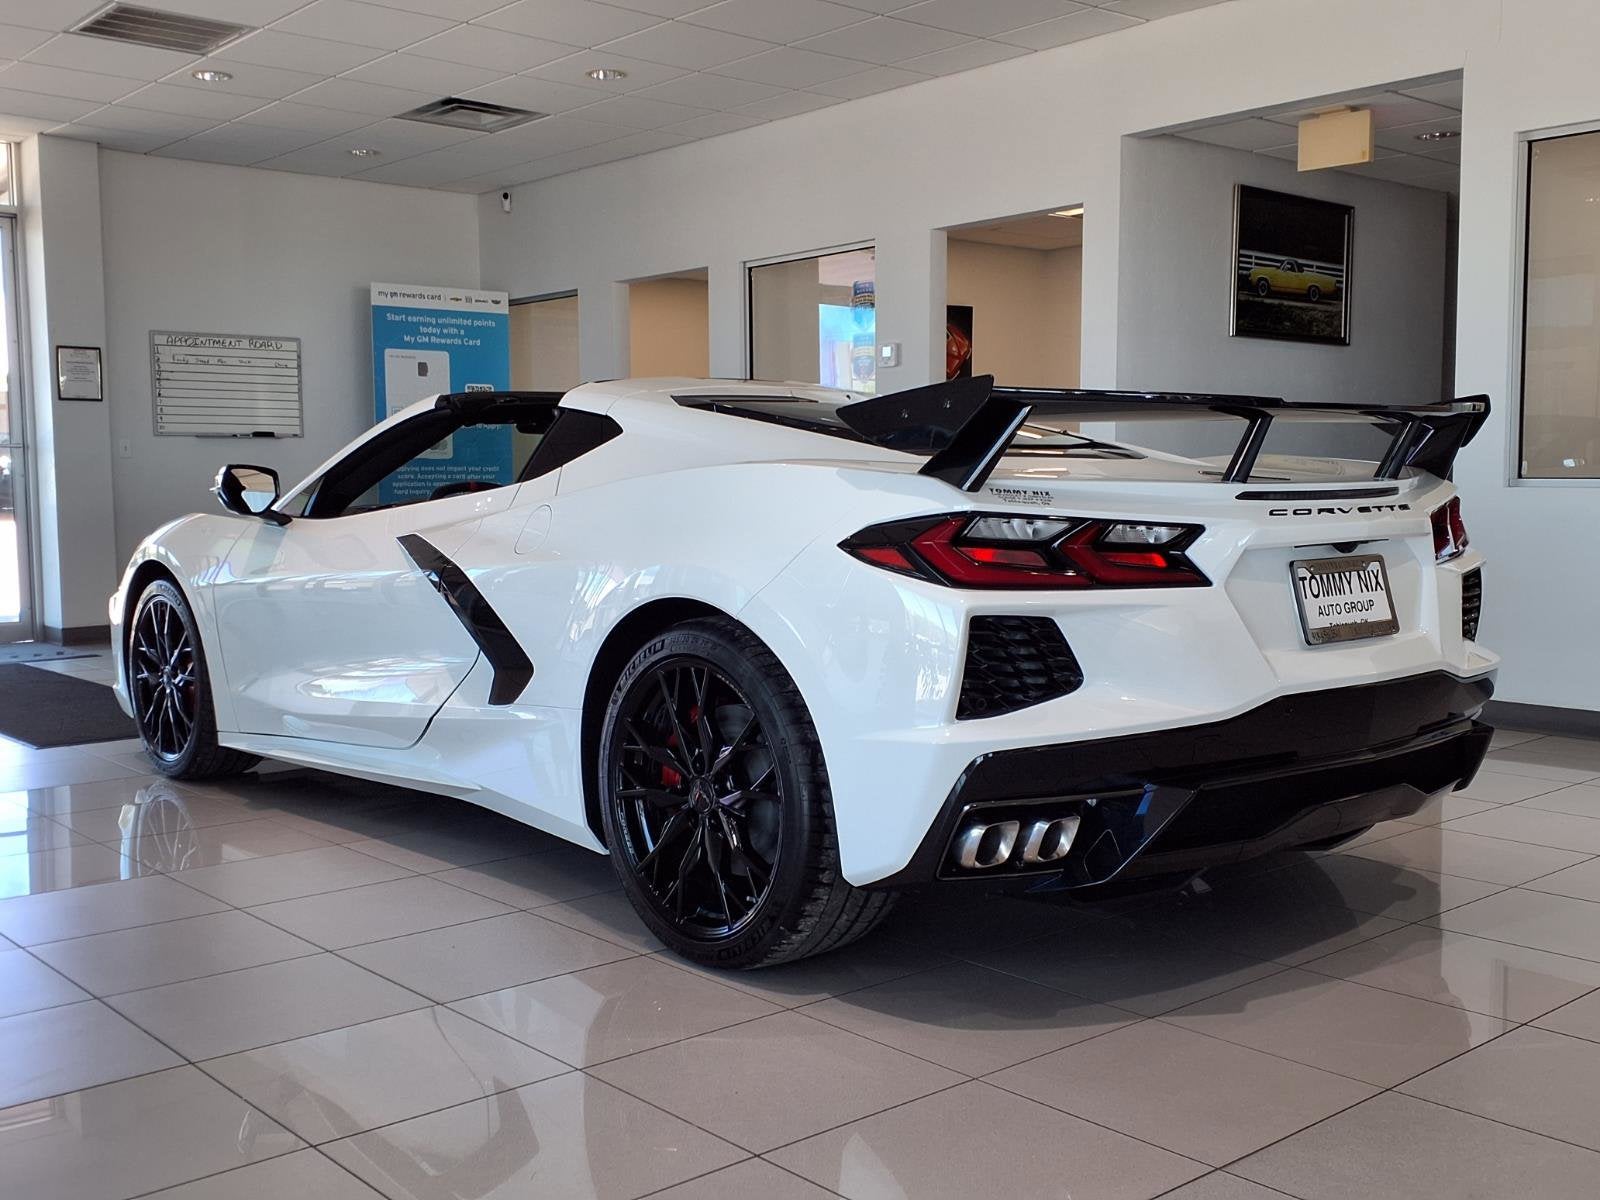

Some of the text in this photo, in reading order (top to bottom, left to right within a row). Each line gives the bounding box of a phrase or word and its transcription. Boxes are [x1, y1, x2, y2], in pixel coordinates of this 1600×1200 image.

[399, 292, 426, 300] rewards
[386, 313, 496, 328] Start earning unlimited points
[420, 326, 440, 335] today
[442, 327, 459, 335] with
[166, 335, 283, 349] APPOINTMENT BOARD
[403, 335, 481, 346] My GM Rewards Card
[1269, 504, 1410, 516] CORVETTE
[1299, 569, 1384, 599] TOMMY NIX
[1318, 599, 1375, 617] AUTO GROUP
